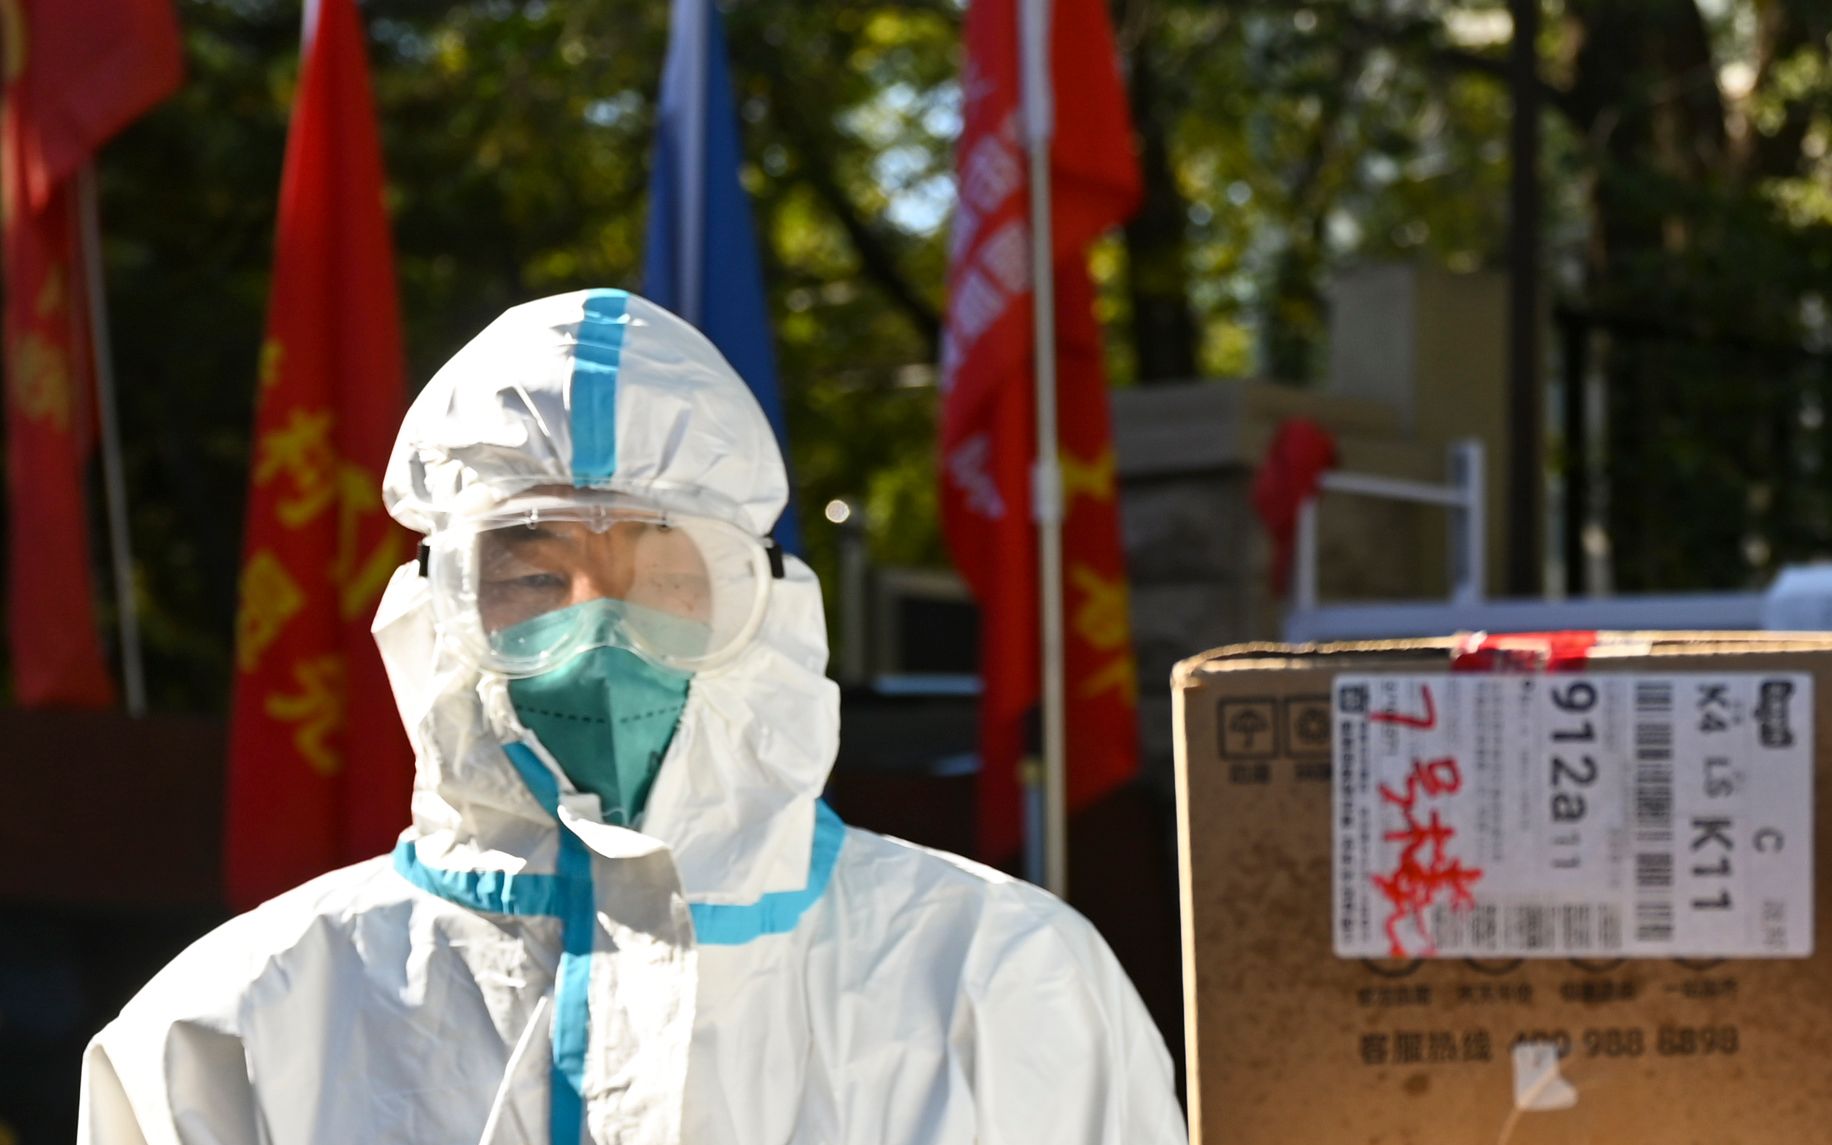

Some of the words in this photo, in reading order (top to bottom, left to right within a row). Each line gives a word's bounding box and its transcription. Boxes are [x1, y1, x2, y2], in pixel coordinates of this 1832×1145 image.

[1697, 683, 1732, 735] K4
[1550, 682, 1598, 824] 912a
[1703, 755, 1734, 799] LS
[1691, 816, 1735, 913] K11
[1754, 827, 1786, 855] C
